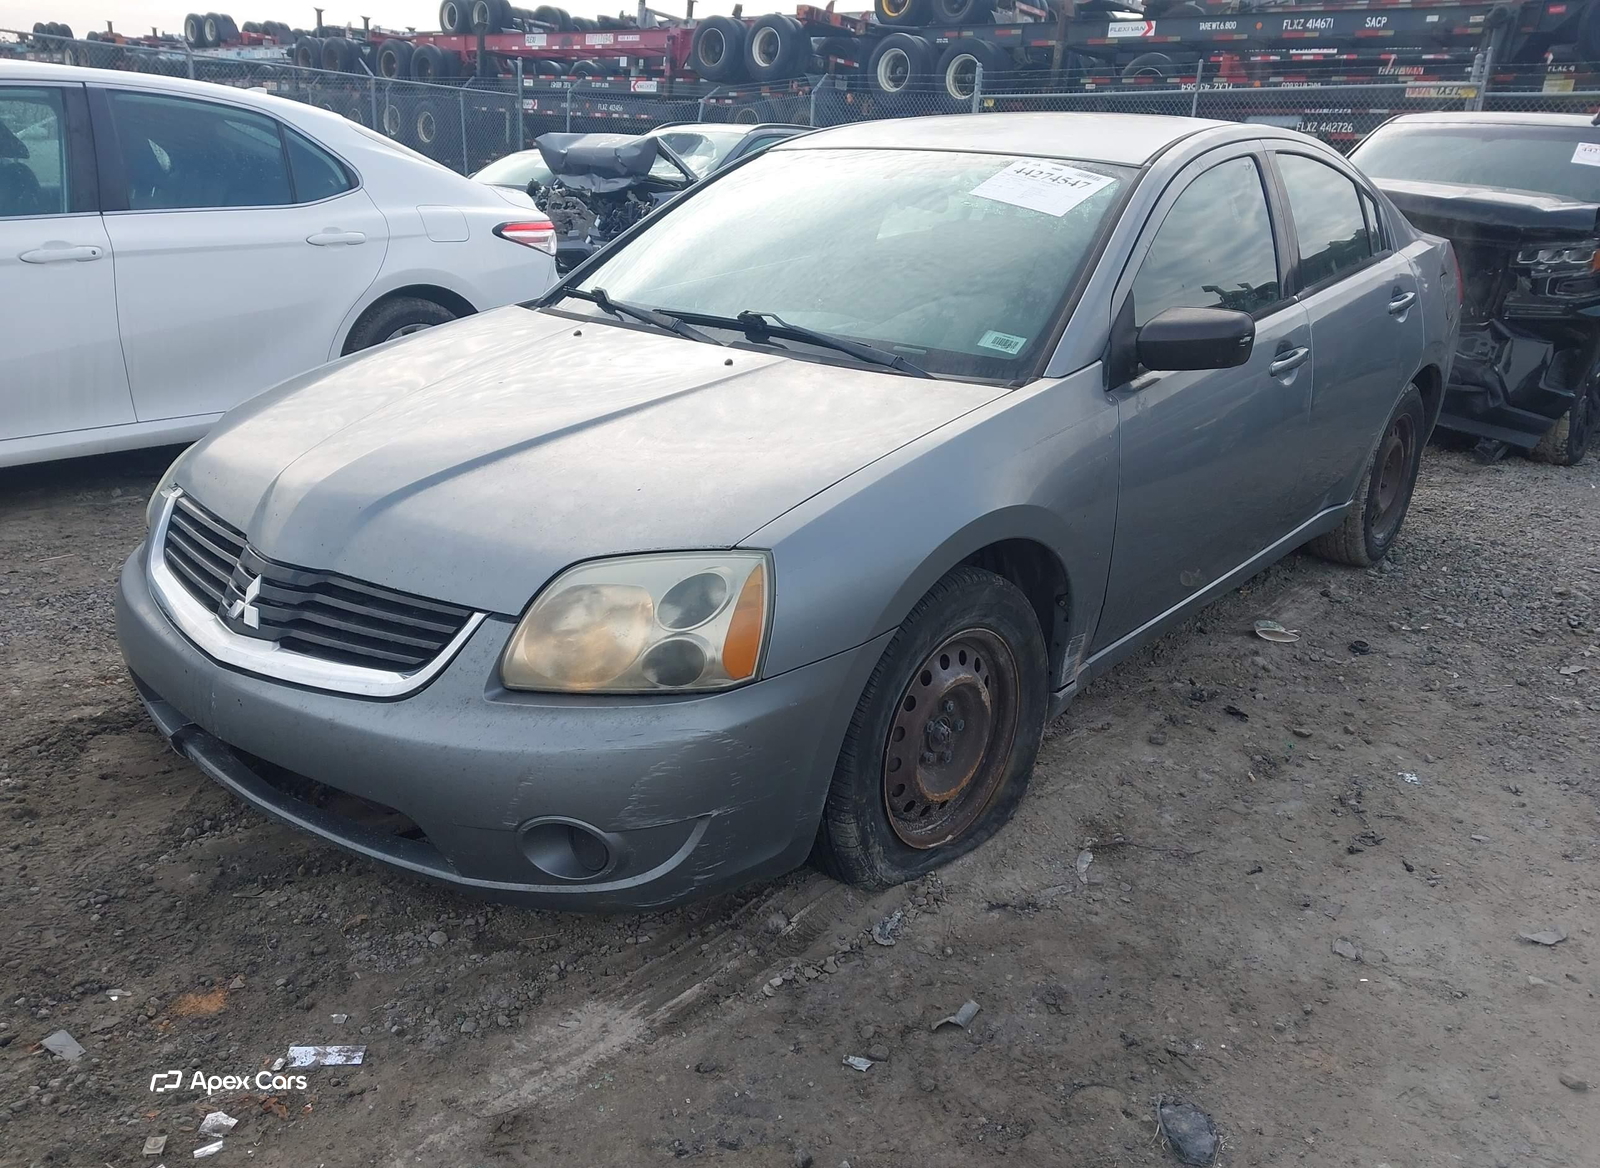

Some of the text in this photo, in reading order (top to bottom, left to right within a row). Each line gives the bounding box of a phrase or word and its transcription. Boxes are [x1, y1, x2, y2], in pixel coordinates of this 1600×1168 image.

[1283, 18, 1334, 30] FLXZ 414671
[1365, 16, 1387, 28] SACP
[1296, 121, 1354, 133] FLXZ 442726
[1013, 167, 1093, 189] 44274547
